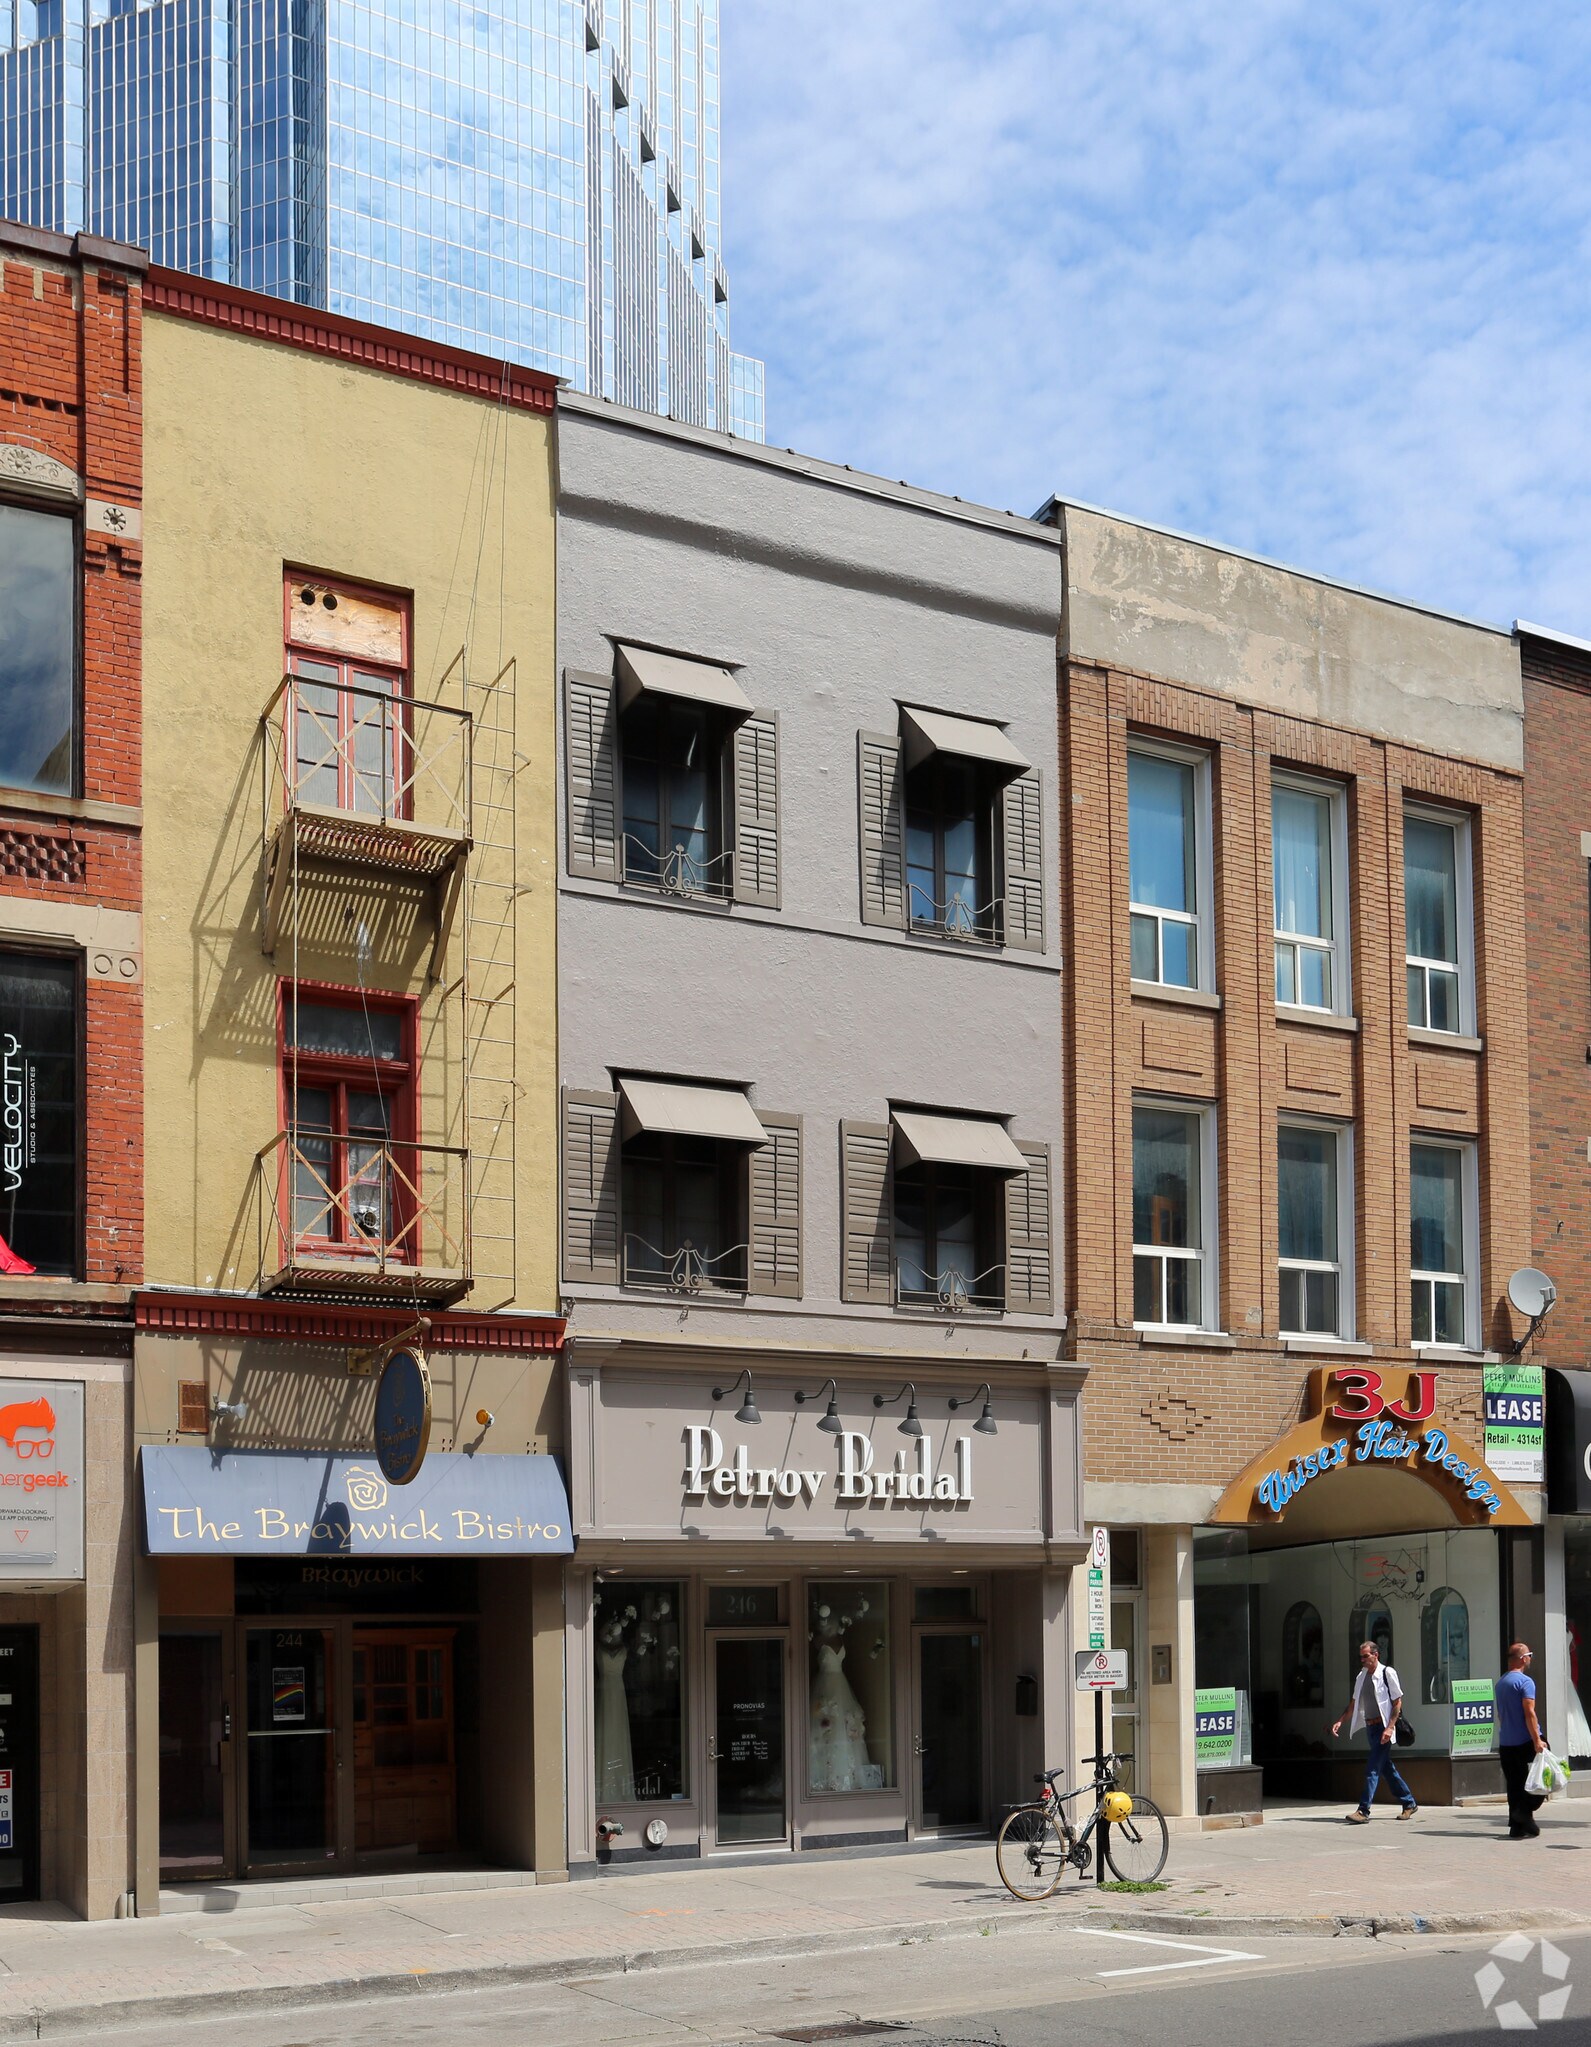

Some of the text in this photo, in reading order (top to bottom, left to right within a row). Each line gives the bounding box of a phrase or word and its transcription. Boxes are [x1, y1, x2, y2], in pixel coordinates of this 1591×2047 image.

[4, 1033, 22, 1192] VELOCITY
[1485, 1373, 1541, 1384] PETER MULLINS
[1486, 1399, 1541, 1421] LEASE
[1487, 1433, 1509, 1443] Retail
[1517, 1434, 1542, 1445] 4314sf
[684, 1425, 976, 1502] Petrov Bridal
[1258, 1437, 1348, 1514] Unisex
[1356, 1420, 1420, 1462] Hair
[1424, 1428, 1503, 1516] Design
[159, 1507, 561, 1549] The Braywick Bistro
[727, 1595, 757, 1614] 246
[276, 1634, 303, 1647] 244
[1456, 1705, 1492, 1720] LEASE
[1456, 1728, 1492, 1737] 519.642.0200
